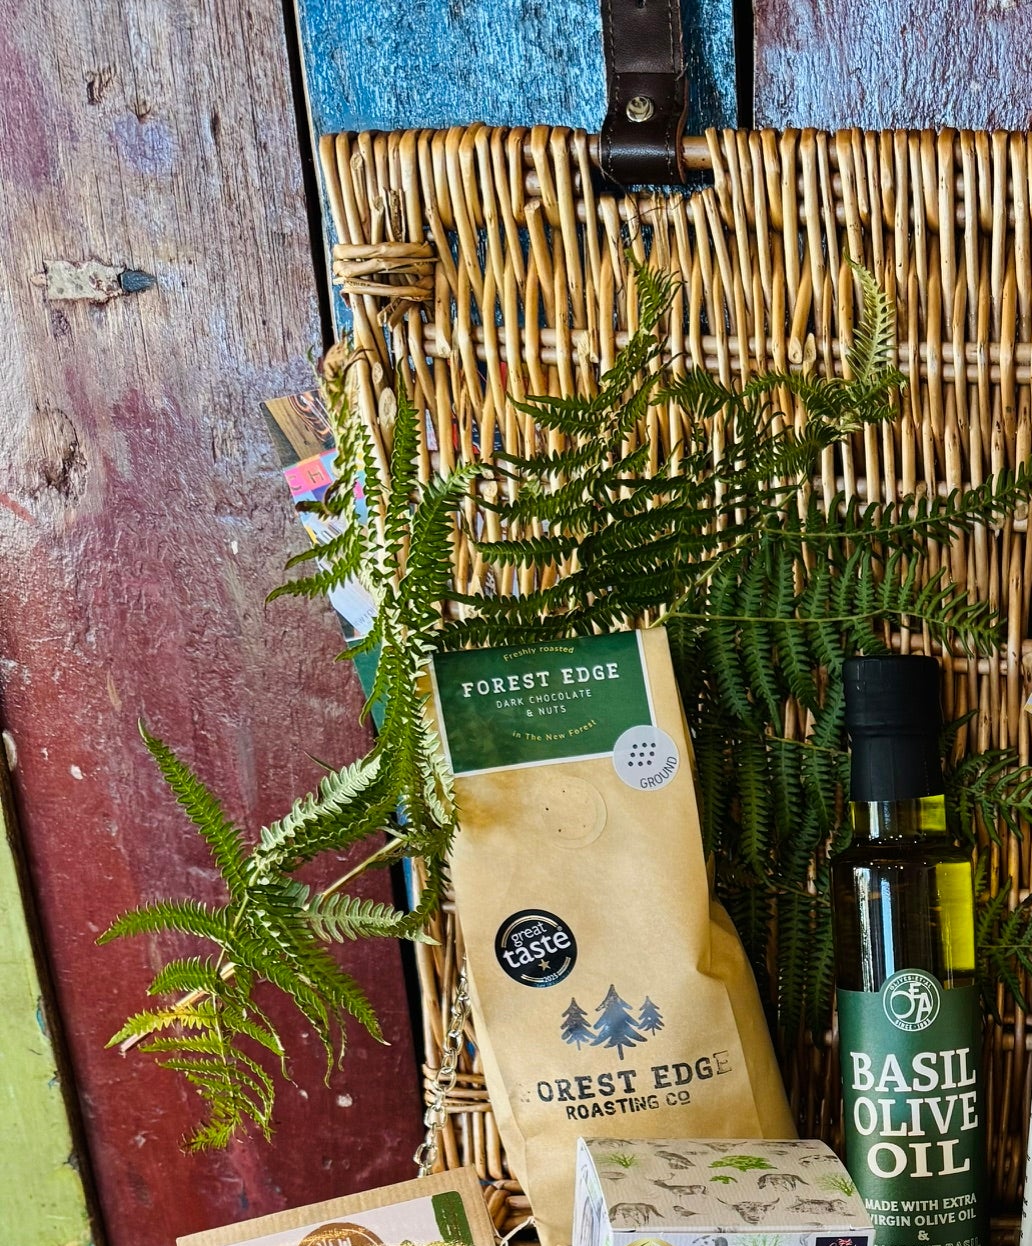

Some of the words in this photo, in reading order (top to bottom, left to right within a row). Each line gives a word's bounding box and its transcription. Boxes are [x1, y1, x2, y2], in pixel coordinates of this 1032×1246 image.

[503, 648, 536, 662] Freshly
[539, 646, 575, 654] roasted
[462, 671, 550, 698] FOREST
[561, 663, 620, 685] EDGE
[496, 697, 524, 709] DARK
[529, 689, 592, 704] CHOCOLATE
[526, 709, 533, 717] &
[538, 705, 567, 716] NUTS
[640, 756, 677, 789] GROUND
[503, 929, 571, 969] taste
[511, 921, 547, 947] great
[651, 1050, 732, 1089] EDGE
[850, 1047, 976, 1092] BASIL
[566, 1093, 659, 1121] ROASTING
[854, 1091, 978, 1136] OLIVE
[867, 1139, 971, 1179] OIL
[914, 1213, 956, 1227] OLIVE
[958, 1208, 977, 1221] OIL
